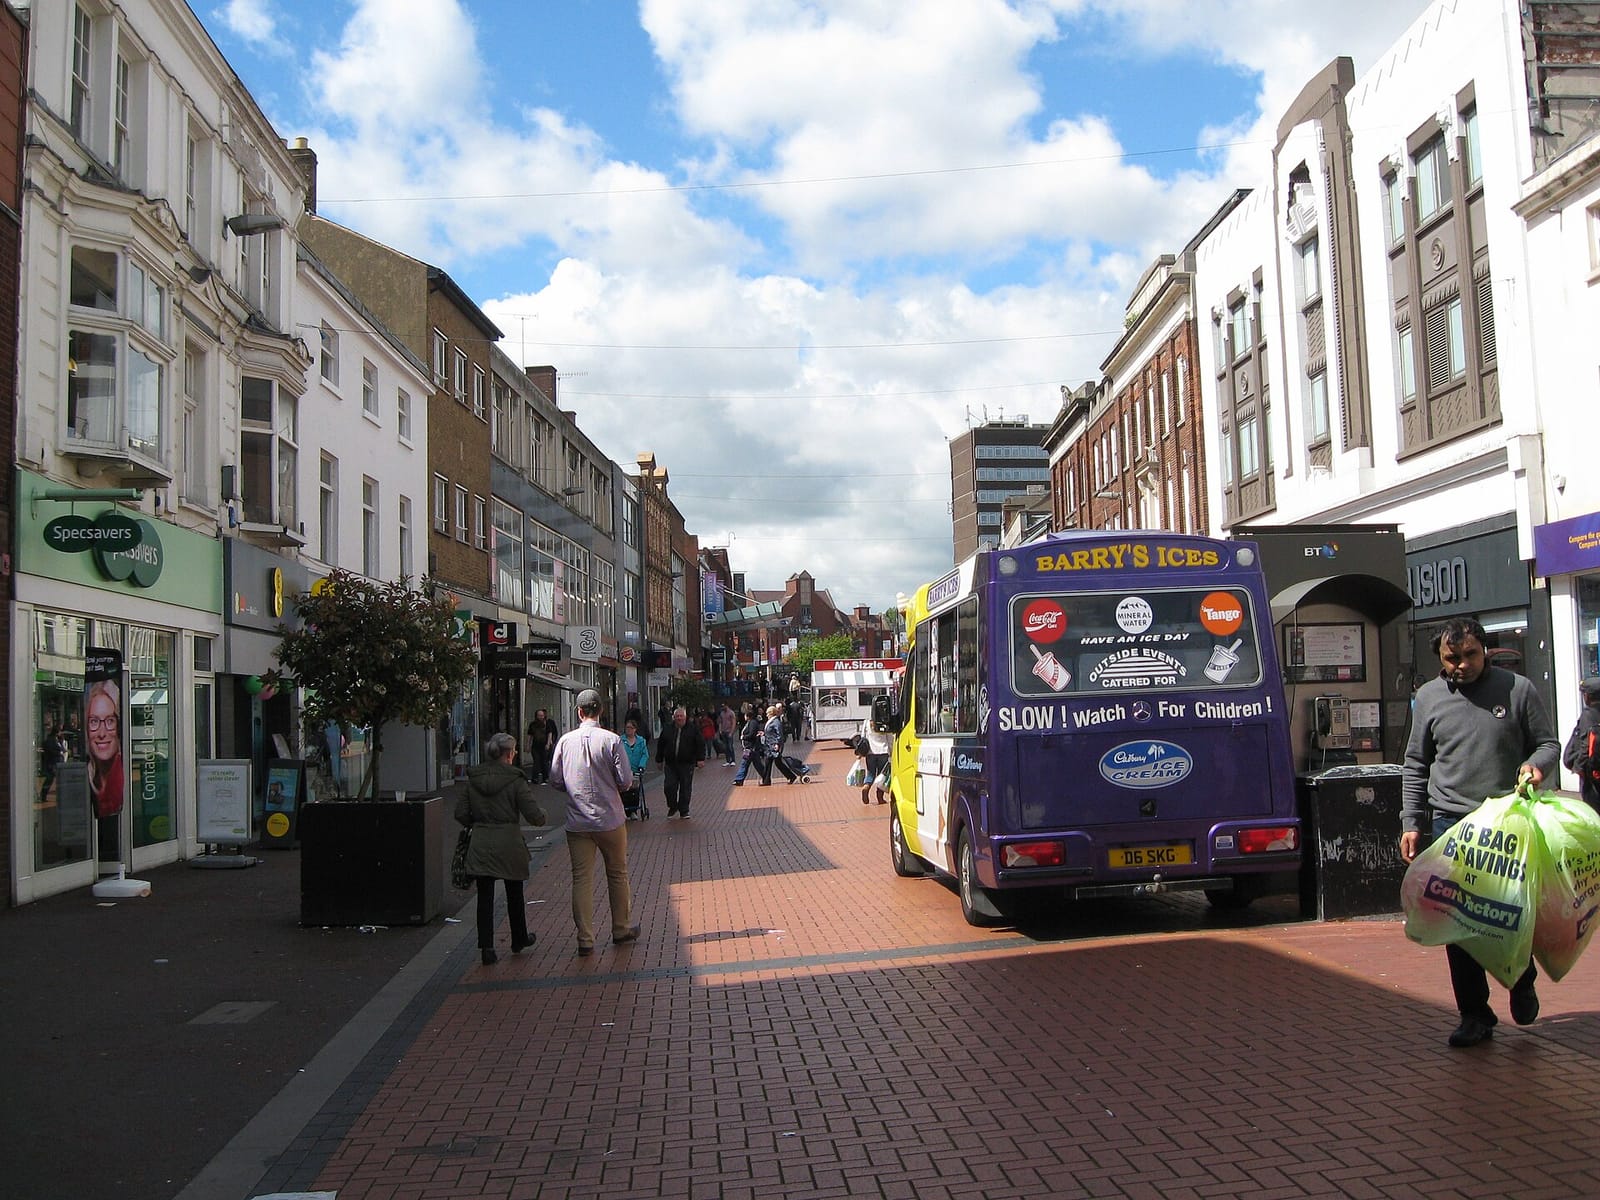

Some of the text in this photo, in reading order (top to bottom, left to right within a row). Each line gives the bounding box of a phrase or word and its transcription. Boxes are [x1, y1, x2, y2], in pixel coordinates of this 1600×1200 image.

[53, 525, 132, 542] Specsavers
[1036, 544, 1219, 571] BARRY'S ICES
[1304, 547, 1322, 557] BT
[1407, 556, 1468, 607] usion
[1117, 612, 1152, 620] MINERAL
[1205, 607, 1240, 621] Tango
[1122, 619, 1148, 627] WATER
[579, 629, 597, 651] 3
[1081, 632, 1190, 645] HAVE AN ICE DAY
[834, 661, 884, 670] Mr.Sizzle
[1089, 648, 1138, 682] OUTSIDE
[1143, 648, 1187, 677] EVENTS
[1102, 676, 1176, 688] CATERED FOR
[998, 705, 1055, 731] SLOW
[1072, 703, 1126, 728] Watch
[1158, 701, 1186, 718] For
[1195, 701, 1262, 719] Children
[1152, 761, 1185, 770] ICE
[143, 747, 156, 800] Contact
[1111, 769, 1182, 779] CREAM
[1459, 822, 1518, 855] IG BAG
[1124, 848, 1176, 865] D6 SKG
[1573, 861, 1596, 878] that
[1464, 872, 1478, 885] AT
